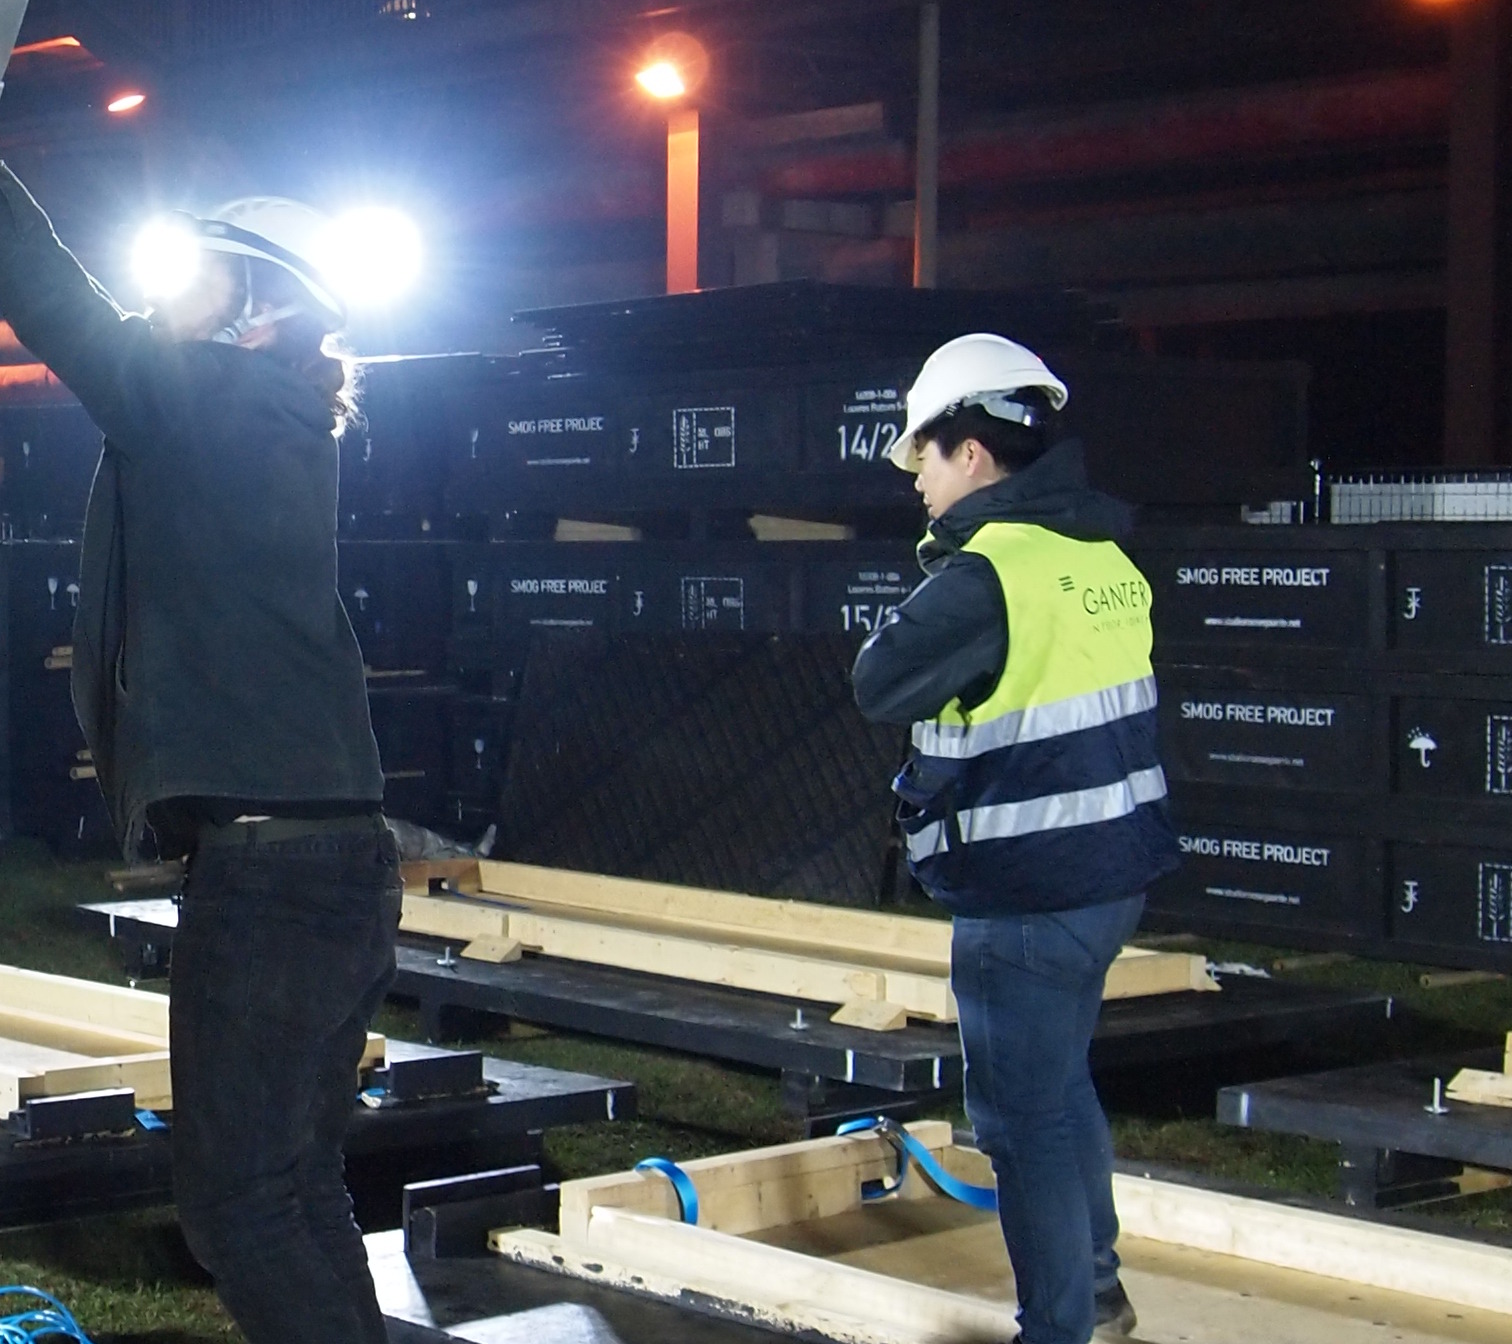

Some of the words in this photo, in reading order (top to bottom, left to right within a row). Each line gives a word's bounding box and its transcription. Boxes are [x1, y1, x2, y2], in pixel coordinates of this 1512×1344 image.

[508, 421, 536, 434] SMOG
[538, 418, 563, 433] FREE
[565, 417, 604, 431] PROJEC
[838, 422, 898, 461] 14/2
[511, 580, 539, 593] SMOG
[541, 579, 567, 593] FREE
[568, 580, 607, 594] PROJEC
[1177, 568, 1219, 585] SMOG
[1222, 568, 1260, 585] FREE
[1262, 568, 1330, 586] PROJECT
[1083, 581, 1149, 615] GANTER
[1181, 702, 1223, 720] SMOG
[1226, 704, 1264, 723] FREE
[1267, 706, 1335, 726] PROJECT
[1178, 836, 1220, 855] SMOG
[1223, 839, 1261, 860] FREE
[1263, 843, 1330, 867] PROJECT
